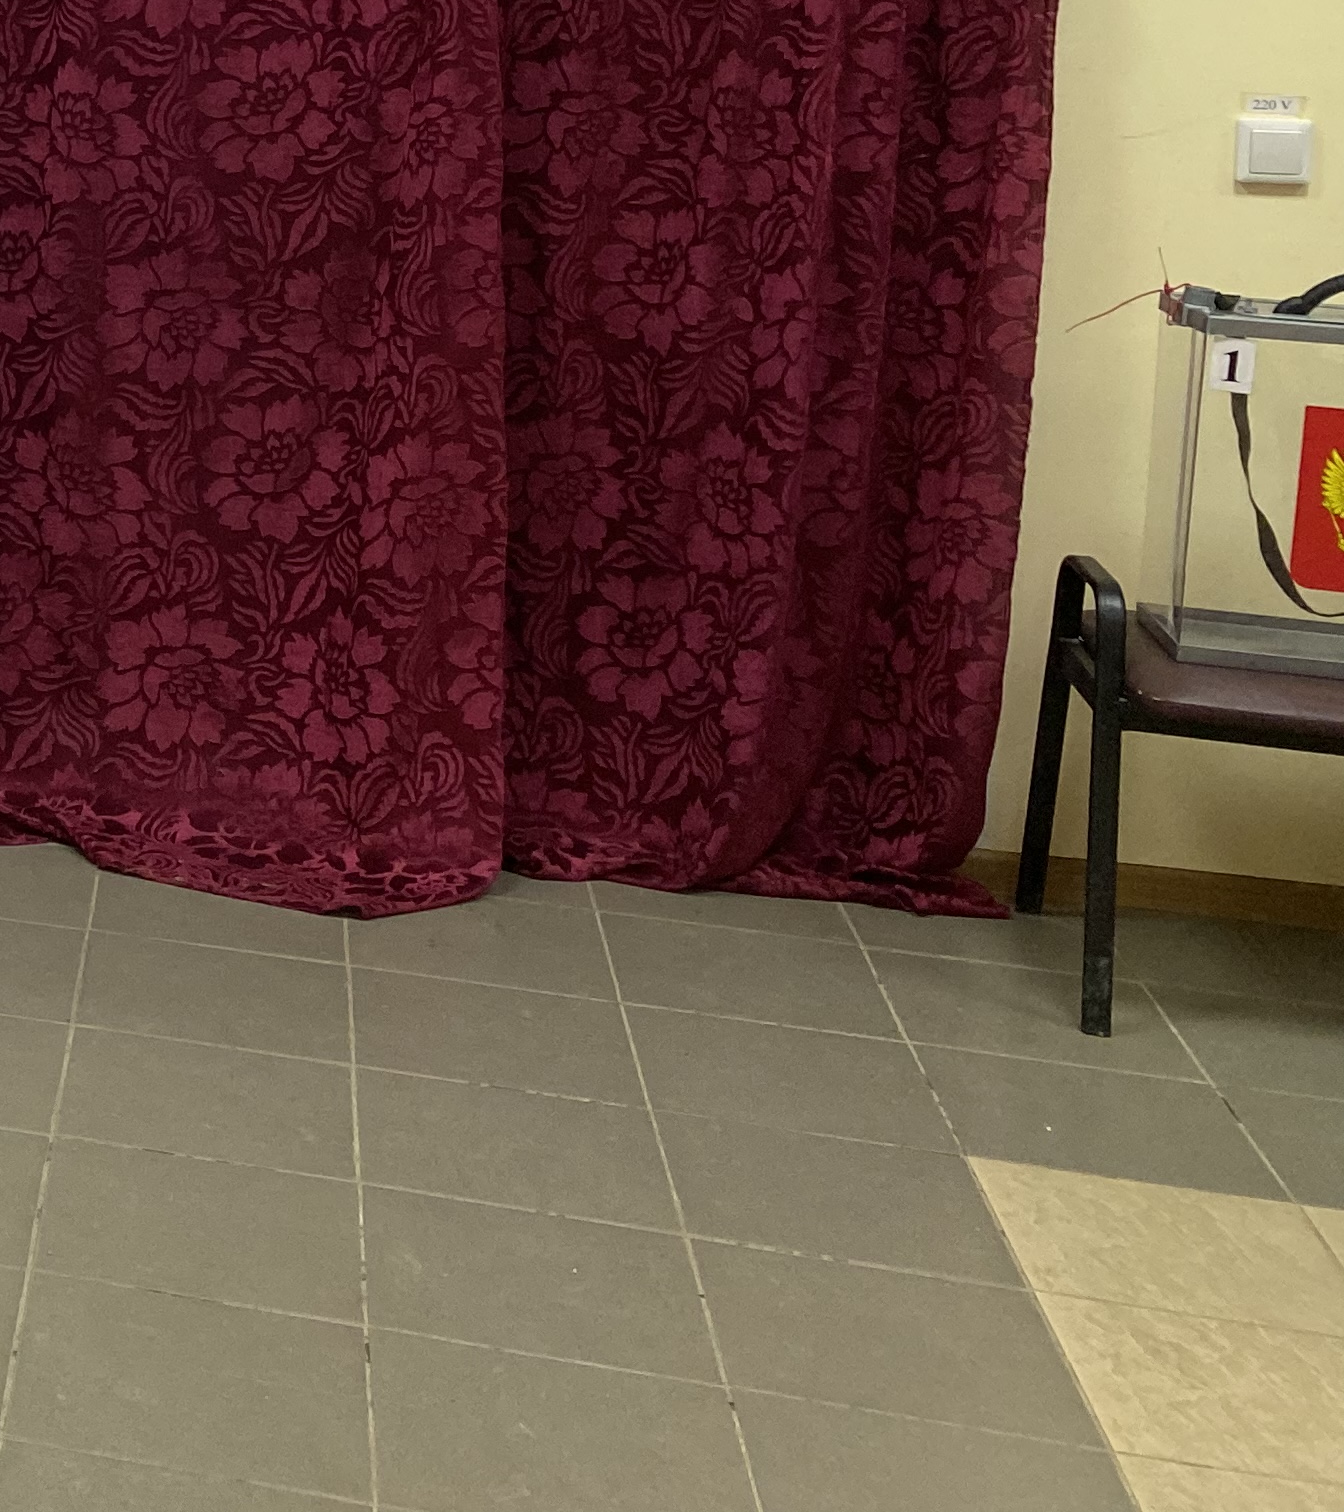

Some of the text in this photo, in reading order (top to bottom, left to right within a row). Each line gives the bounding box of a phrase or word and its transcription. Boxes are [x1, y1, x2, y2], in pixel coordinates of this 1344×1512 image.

[1253, 99, 1293, 110] 220 V
[1221, 349, 1240, 384] 1
